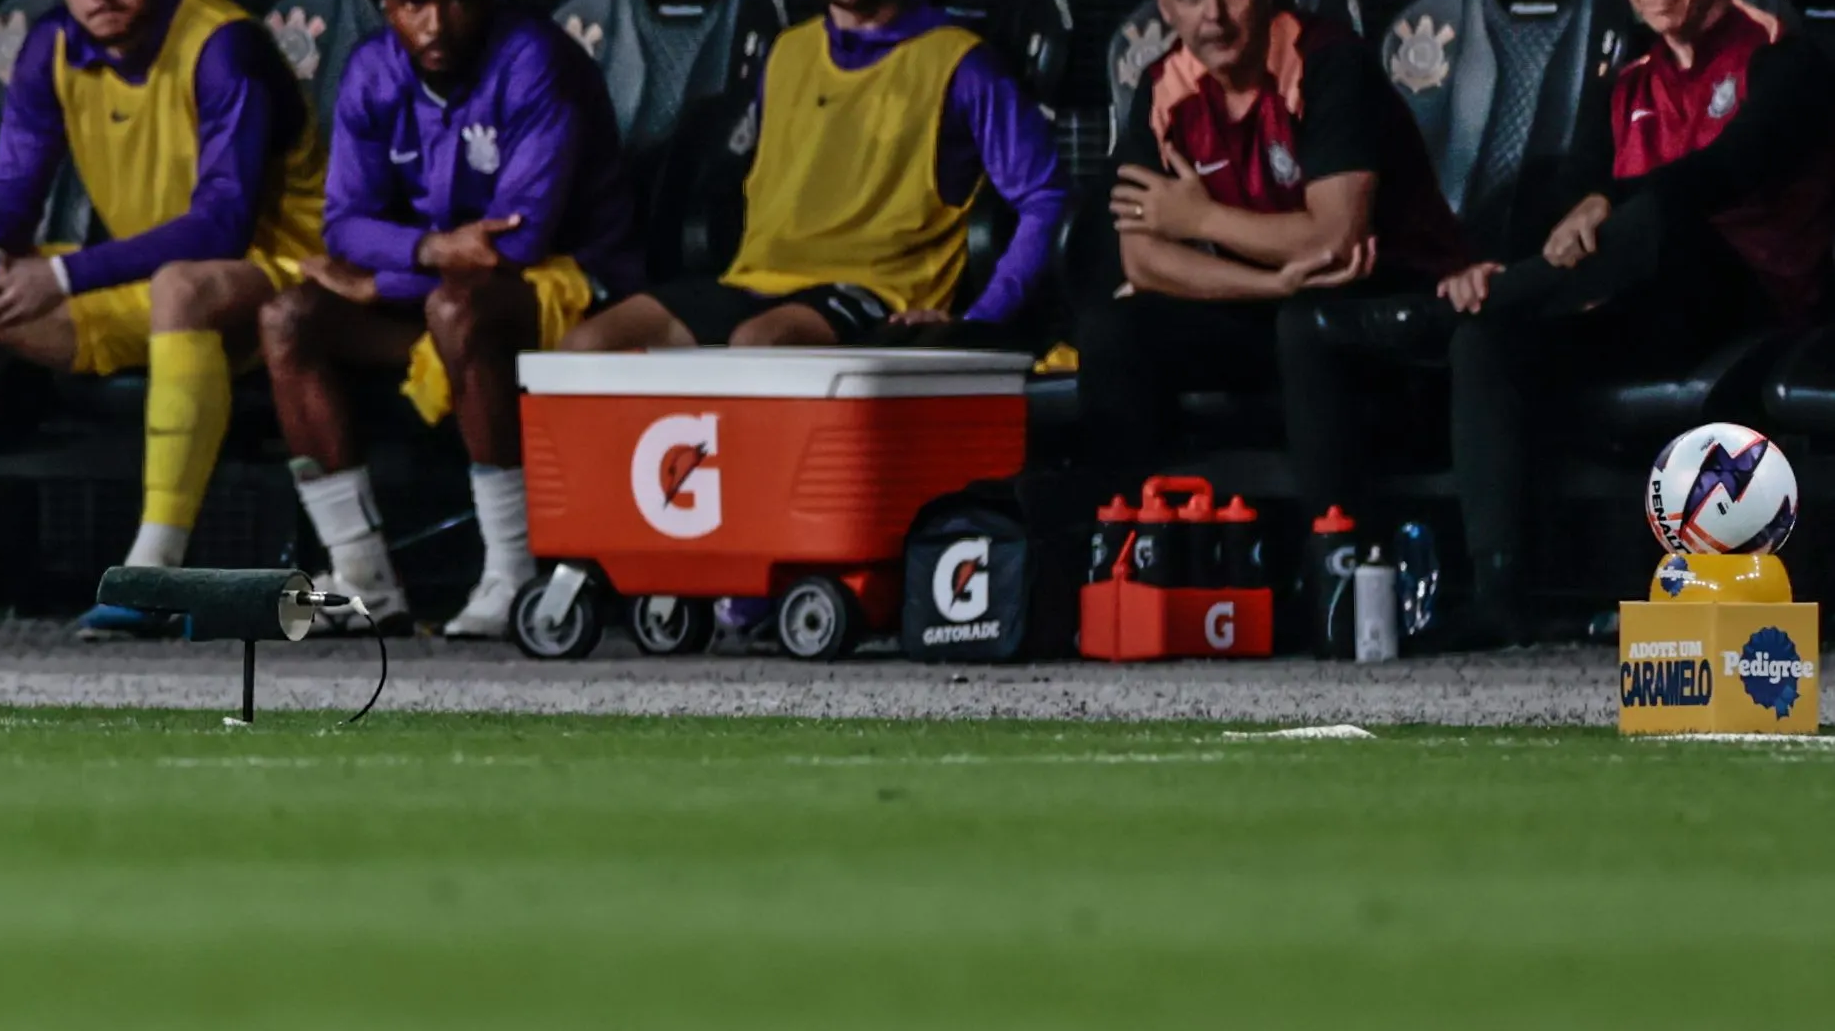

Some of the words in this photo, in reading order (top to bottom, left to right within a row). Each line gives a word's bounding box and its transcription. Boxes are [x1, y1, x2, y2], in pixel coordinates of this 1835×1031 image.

[631, 413, 722, 539] G
[1652, 480, 1692, 554] PENALT
[932, 535, 992, 623] G
[922, 619, 1001, 647] GATORADE
[1204, 601, 1235, 651] G
[1629, 641, 1677, 659] ADOTE
[1679, 640, 1703, 657] UM
[1620, 659, 1713, 708] CARAMELO
[1721, 651, 1814, 685] Pedigree
